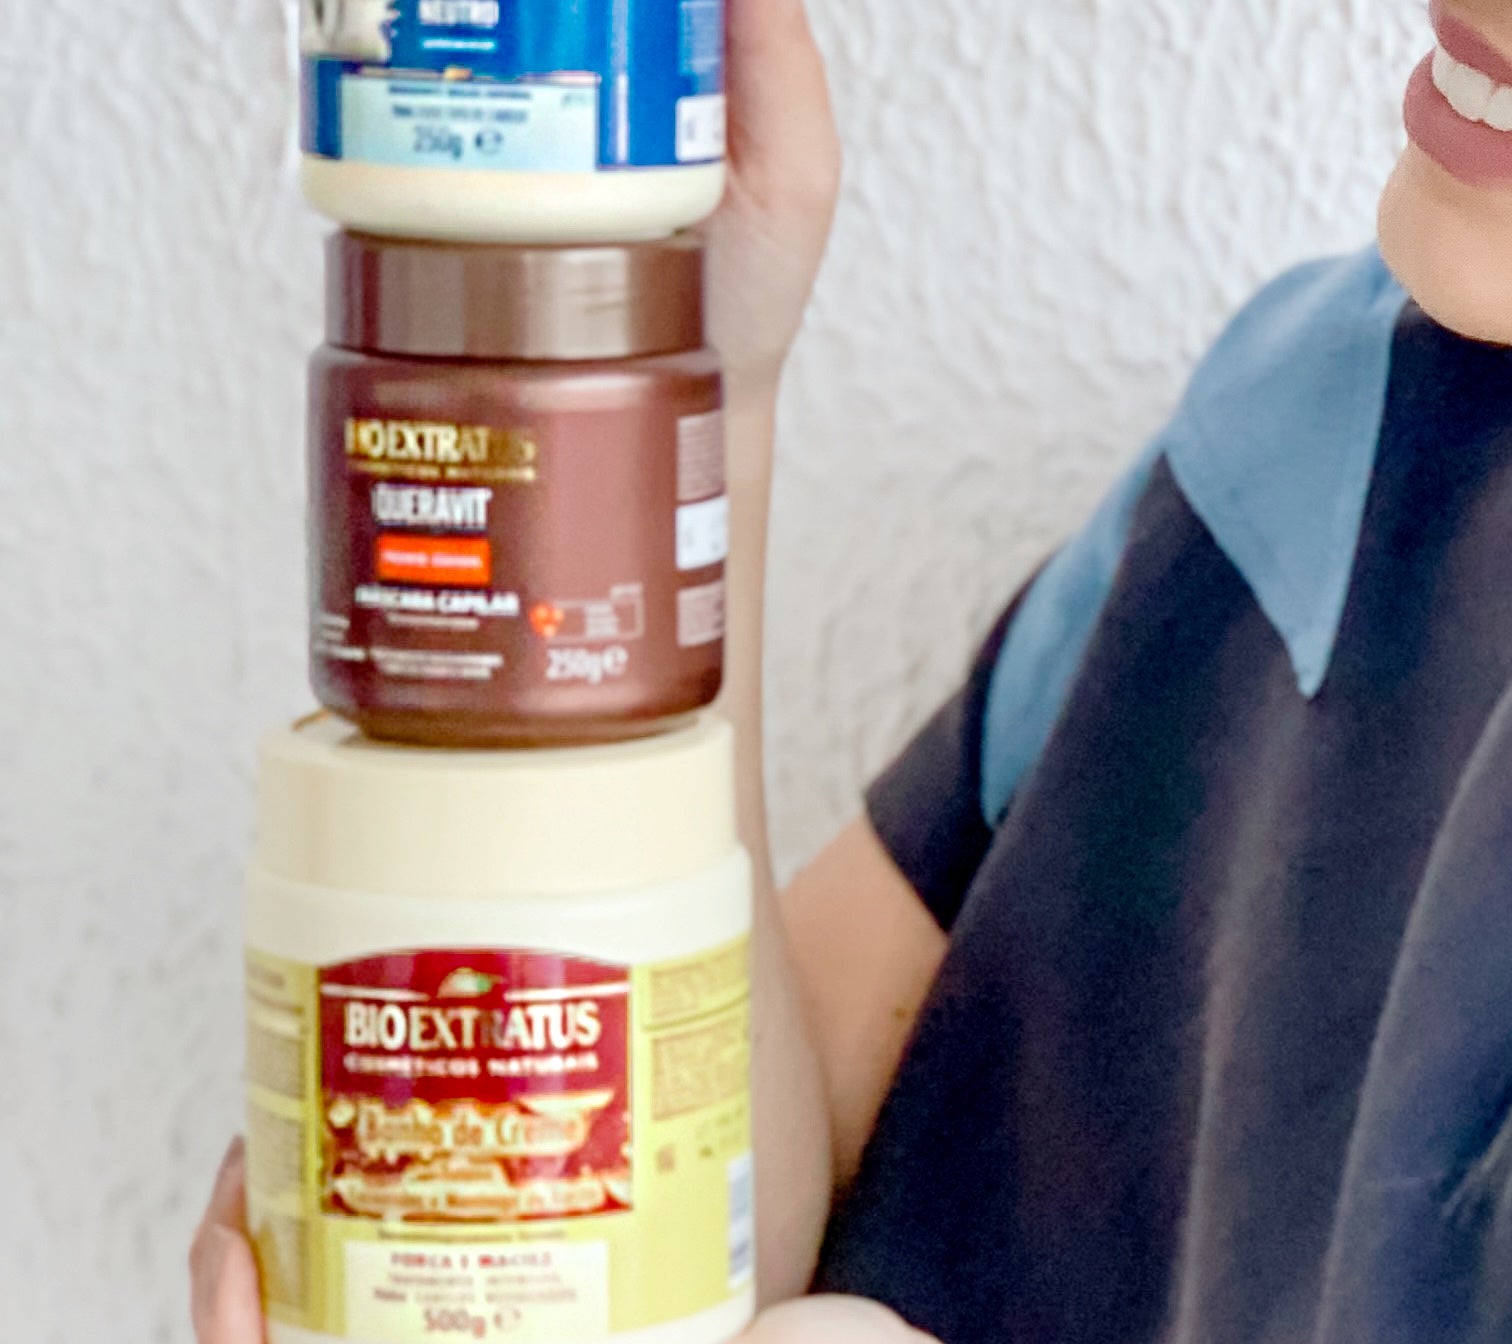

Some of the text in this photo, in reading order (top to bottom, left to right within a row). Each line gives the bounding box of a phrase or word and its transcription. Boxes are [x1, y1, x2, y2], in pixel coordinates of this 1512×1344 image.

[345, 417, 538, 463] IOEXTRAT
[343, 1001, 602, 1051] BIOEXTRATUS
[423, 1308, 486, 1339] 500g
